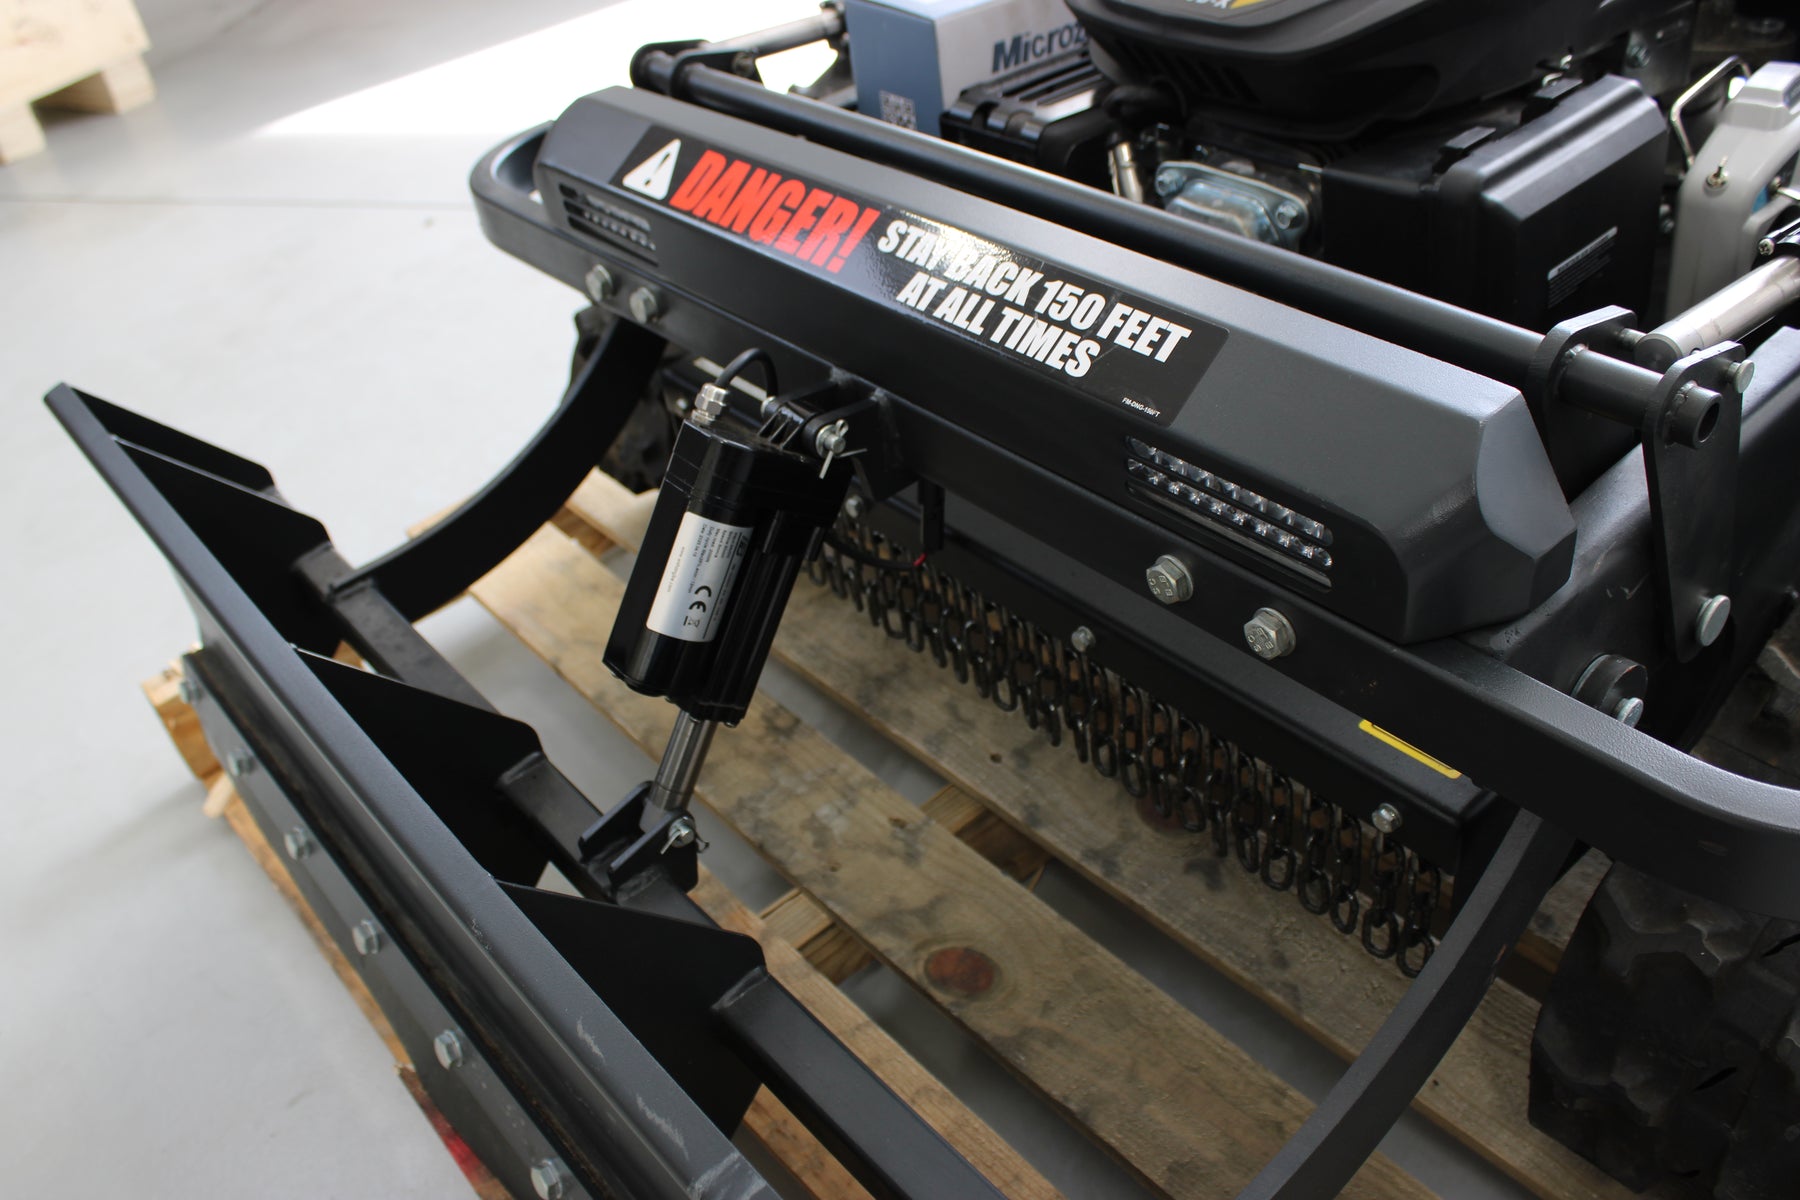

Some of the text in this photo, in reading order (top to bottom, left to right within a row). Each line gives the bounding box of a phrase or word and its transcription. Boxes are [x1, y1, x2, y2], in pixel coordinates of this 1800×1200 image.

[669, 149, 880, 274] DANGER!
[877, 219, 1193, 363] STAY BACK 150 FEET
[896, 271, 1101, 378] AT ALL TIMES
